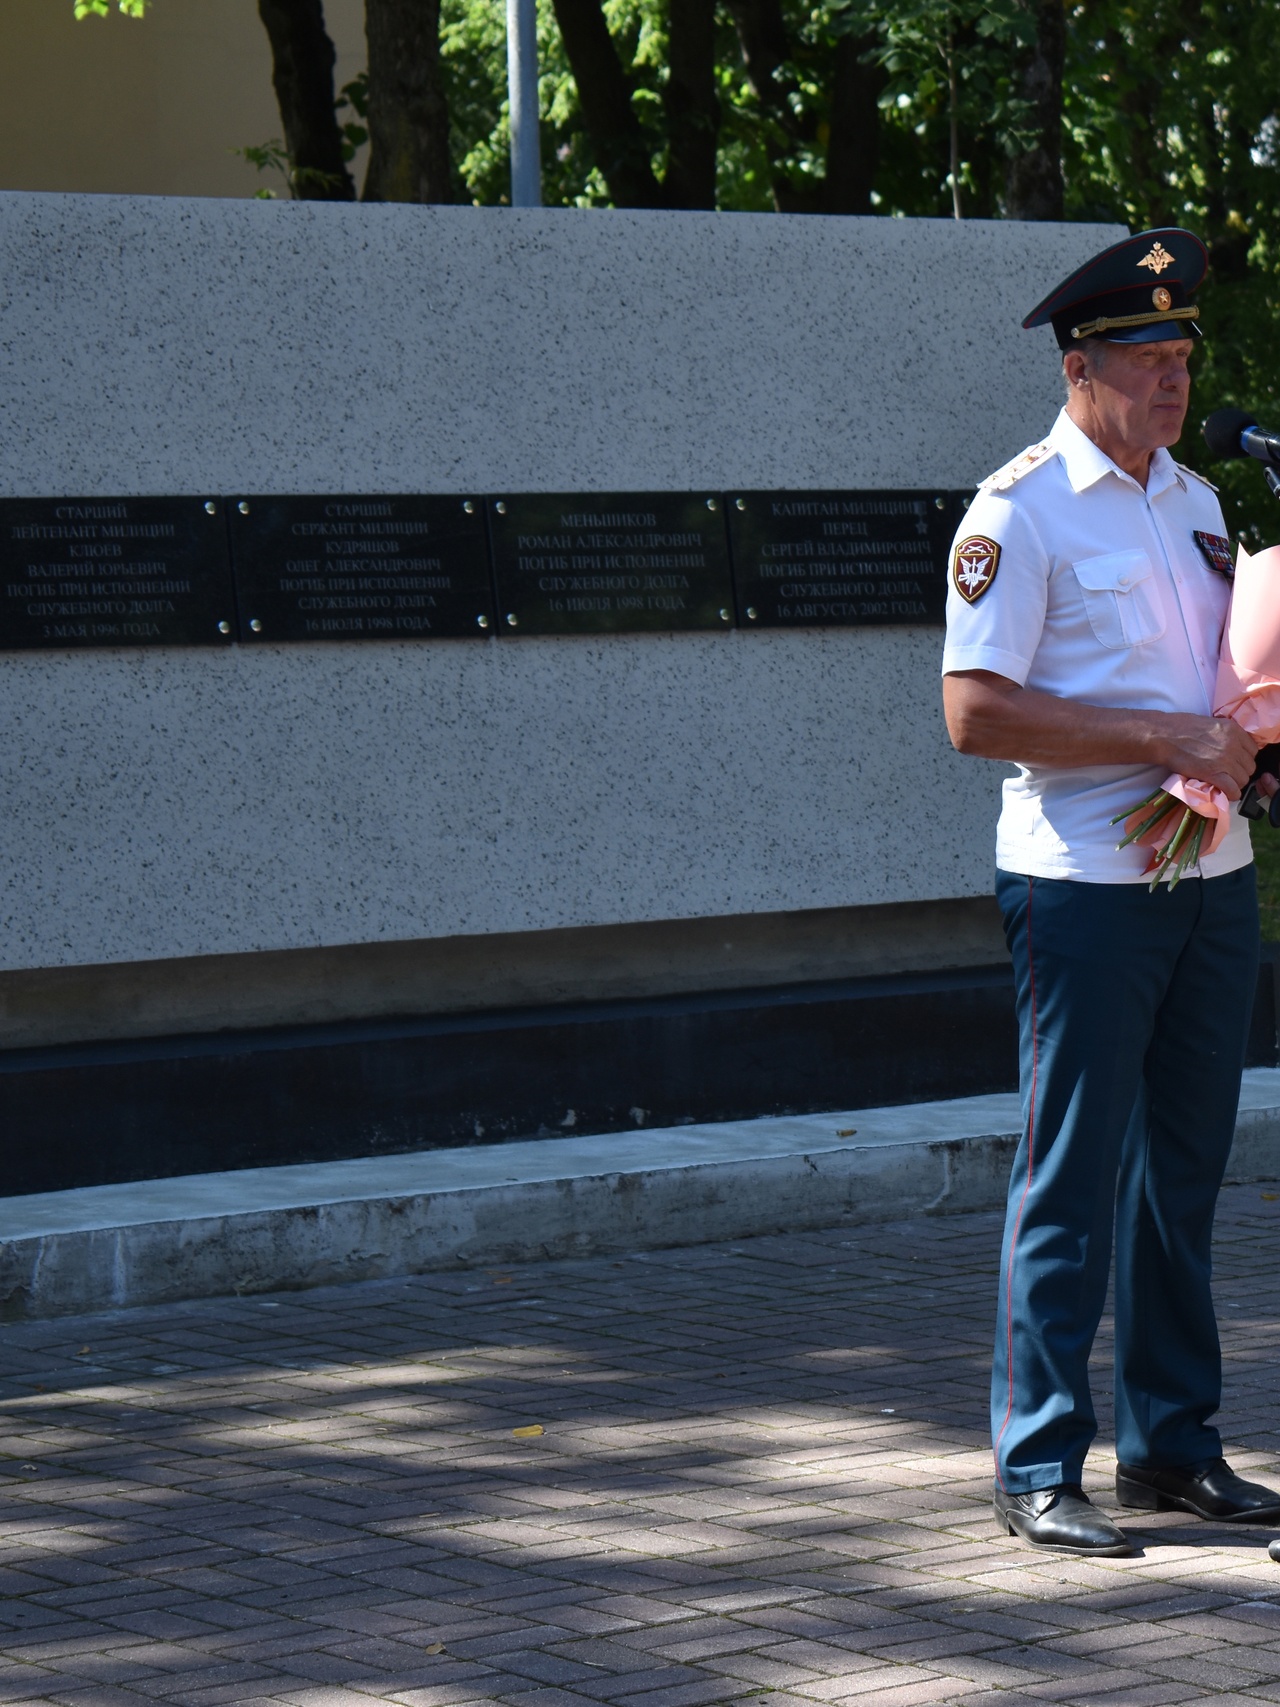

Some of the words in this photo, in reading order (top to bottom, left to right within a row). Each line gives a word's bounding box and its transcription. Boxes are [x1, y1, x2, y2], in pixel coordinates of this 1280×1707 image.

[56, 503, 128, 519] СТАРШИЙ
[325, 502, 393, 516] СТАРШИЙ
[772, 502, 840, 516] КАПИТАН
[843, 502, 913, 516] МИЛИЦИИ
[560, 513, 656, 527] МЕНЬШИКОВ
[11, 524, 98, 539] ЛЕЙТЕНАНТ
[101, 524, 175, 538] МИЛИЦИИ
[292, 522, 355, 535] СЕРЖАНТ
[359, 522, 428, 535] МИЛИЦИИ
[823, 522, 868, 536] ПЕРЕЦ
[326, 541, 399, 554] КУДРЯШОВ
[518, 535, 572, 549] РОМАН
[576, 534, 702, 549] АЛЕКСАНДРОВИЧ
[762, 541, 814, 557] СЕРГЕЙ
[817, 541, 932, 556] ВЛАДИМИРОВИЧ
[69, 544, 122, 557] КЛЮЕВ
[28, 561, 94, 577] ВАЛЕРИЙ
[98, 563, 167, 575] ЮРЬЕВИЧ
[286, 560, 320, 572] ОЛЕГ
[324, 559, 441, 572] АЛЕКСАНДРОВИЧ
[519, 556, 568, 570] ПОГИБ
[572, 556, 601, 569] ПРИ
[605, 554, 705, 568] ИСПОЛНЕНИИ
[760, 564, 806, 577] ПОГИБ
[810, 563, 836, 576] ПРИ
[840, 561, 934, 575] ИСПОЛНЕНИИ
[7, 584, 56, 597] ПОГИБ
[60, 583, 88, 595] ПРИ
[92, 581, 191, 595] ИСПОЛНЕНИИ
[280, 579, 325, 591] ПОГИБ
[329, 578, 355, 590] ПРИ
[359, 576, 450, 590] ИСПОЛНЕНИИ
[539, 576, 640, 591] СЛУЖЕБНОГО
[643, 575, 689, 590] ДОЛГА
[780, 583, 875, 597] СЛУЖЕБНОГО
[878, 581, 922, 596] ДОЛГА
[27, 601, 126, 616] СЛУЖЕБНОГО
[129, 600, 175, 614] ДОЛГА
[298, 596, 390, 610] СЛУЖЕБНОГО
[394, 595, 436, 609] ДОЛГА
[549, 598, 563, 611] 16
[567, 597, 610, 611] ИЮЛЯ
[647, 595, 685, 610] ГОДА
[777, 604, 790, 617] 16
[795, 603, 857, 617] АВГУСТА
[861, 602, 888, 615] 2002
[892, 601, 927, 615] ГОДА
[54, 625, 87, 637] МАЯ
[123, 623, 160, 637] ГОДА
[306, 619, 319, 631] 16
[322, 618, 363, 630] ИЮЛЯ
[396, 616, 431, 630] ГОДА
